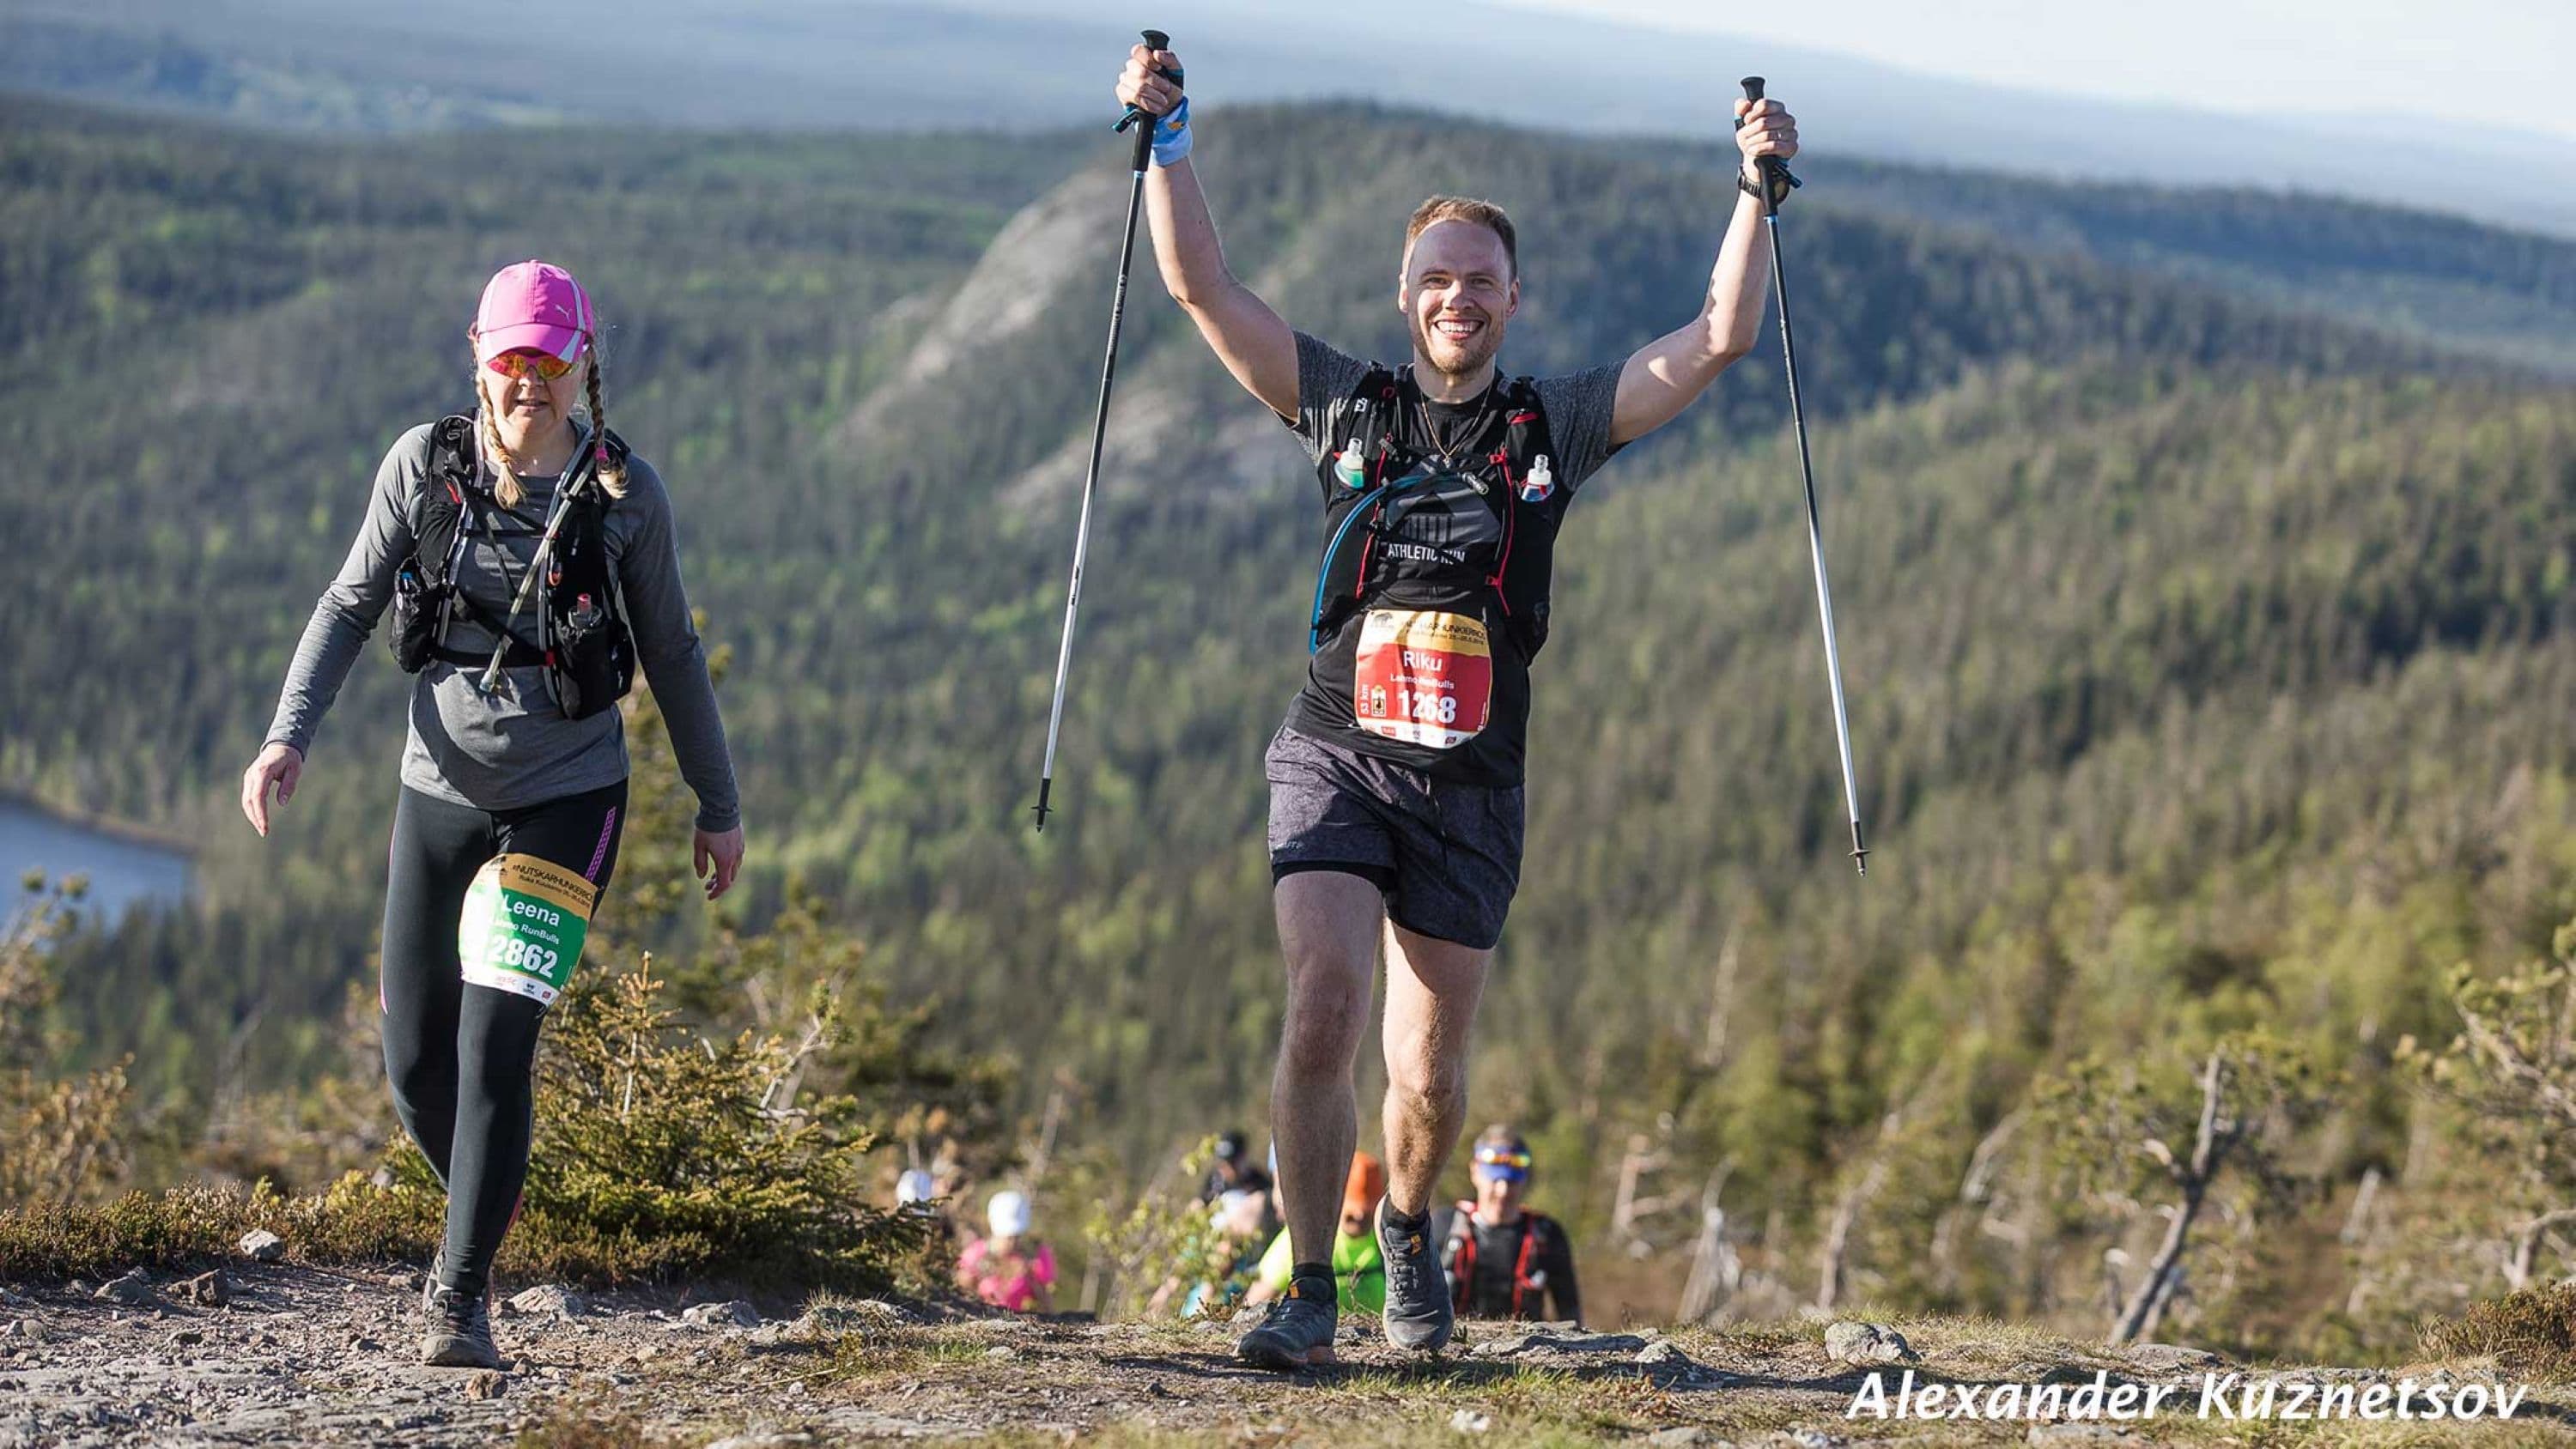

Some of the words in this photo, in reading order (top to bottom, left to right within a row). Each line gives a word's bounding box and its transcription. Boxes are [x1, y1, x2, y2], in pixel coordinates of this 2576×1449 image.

[1388, 543, 1438, 561] ATHLETIC
[1403, 651, 1443, 671] Riku
[1397, 689, 1457, 724] 1268
[501, 894, 561, 927] Leena
[520, 924, 560, 945] RunBulls
[488, 934, 558, 979] 2862
